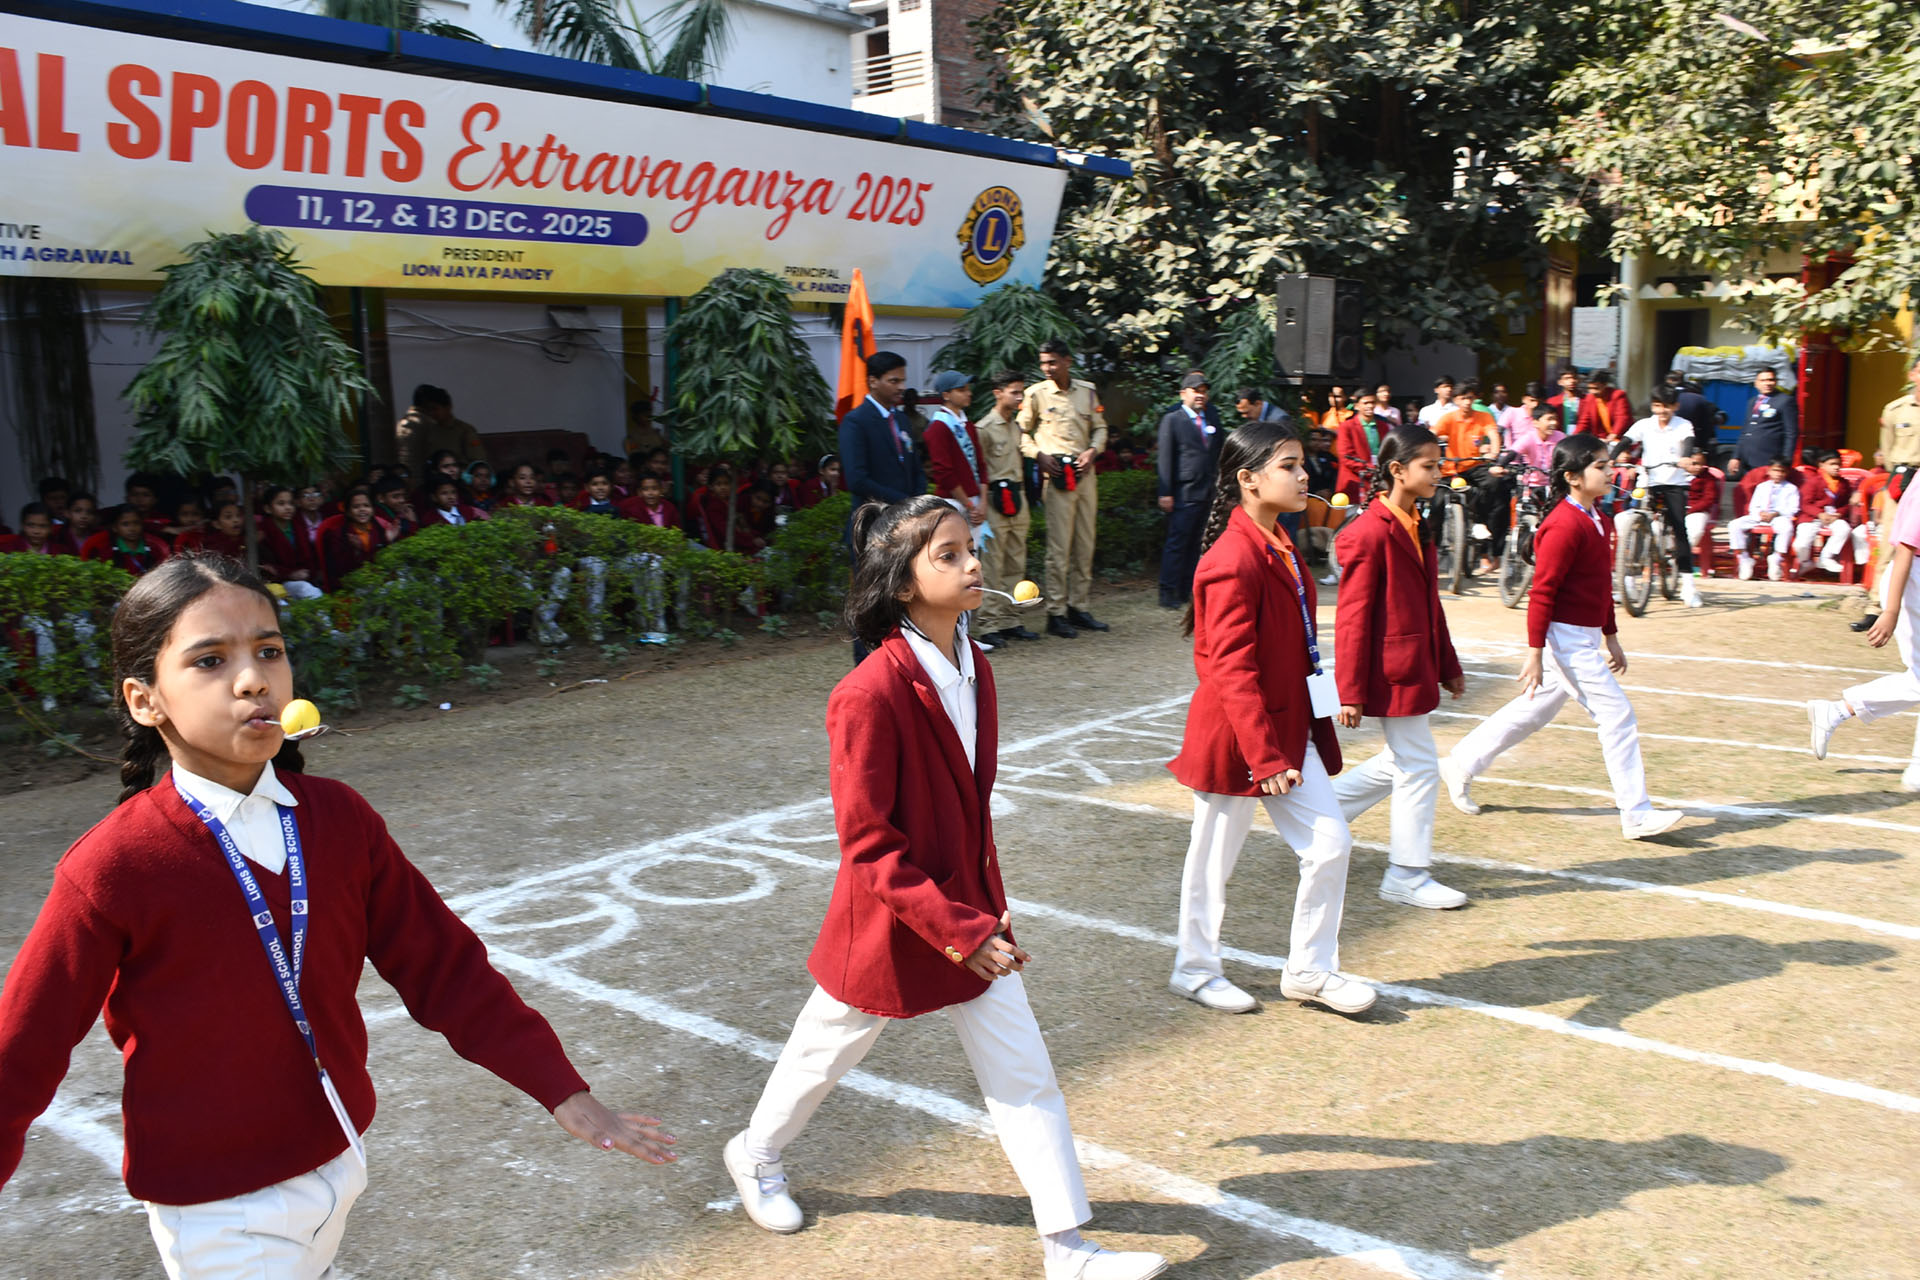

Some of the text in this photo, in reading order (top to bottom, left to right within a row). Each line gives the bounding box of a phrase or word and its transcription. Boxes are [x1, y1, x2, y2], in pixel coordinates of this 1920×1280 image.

[106, 62, 426, 183] SPORTS
[447, 102, 844, 241] Extravaganza
[847, 171, 934, 227] 2025
[297, 195, 613, 238] 11, 12, & 13 DEC. 2025
[978, 189, 1019, 212] LIONS
[981, 217, 1002, 252] L
[21, 246, 135, 266] AGRAWAL
[402, 263, 554, 282] LION JAYA PANDEY
[443, 247, 525, 263] PRESIDENT
[784, 265, 840, 280] PRINCIPAL
[810, 282, 852, 293] PANDE
[219, 829, 261, 901] LIONS SCHOOL
[282, 814, 302, 886] LIONS SCHOOL
[293, 928, 304, 971] SCHOOL
[268, 937, 300, 1010] LIONS SCHOOL
